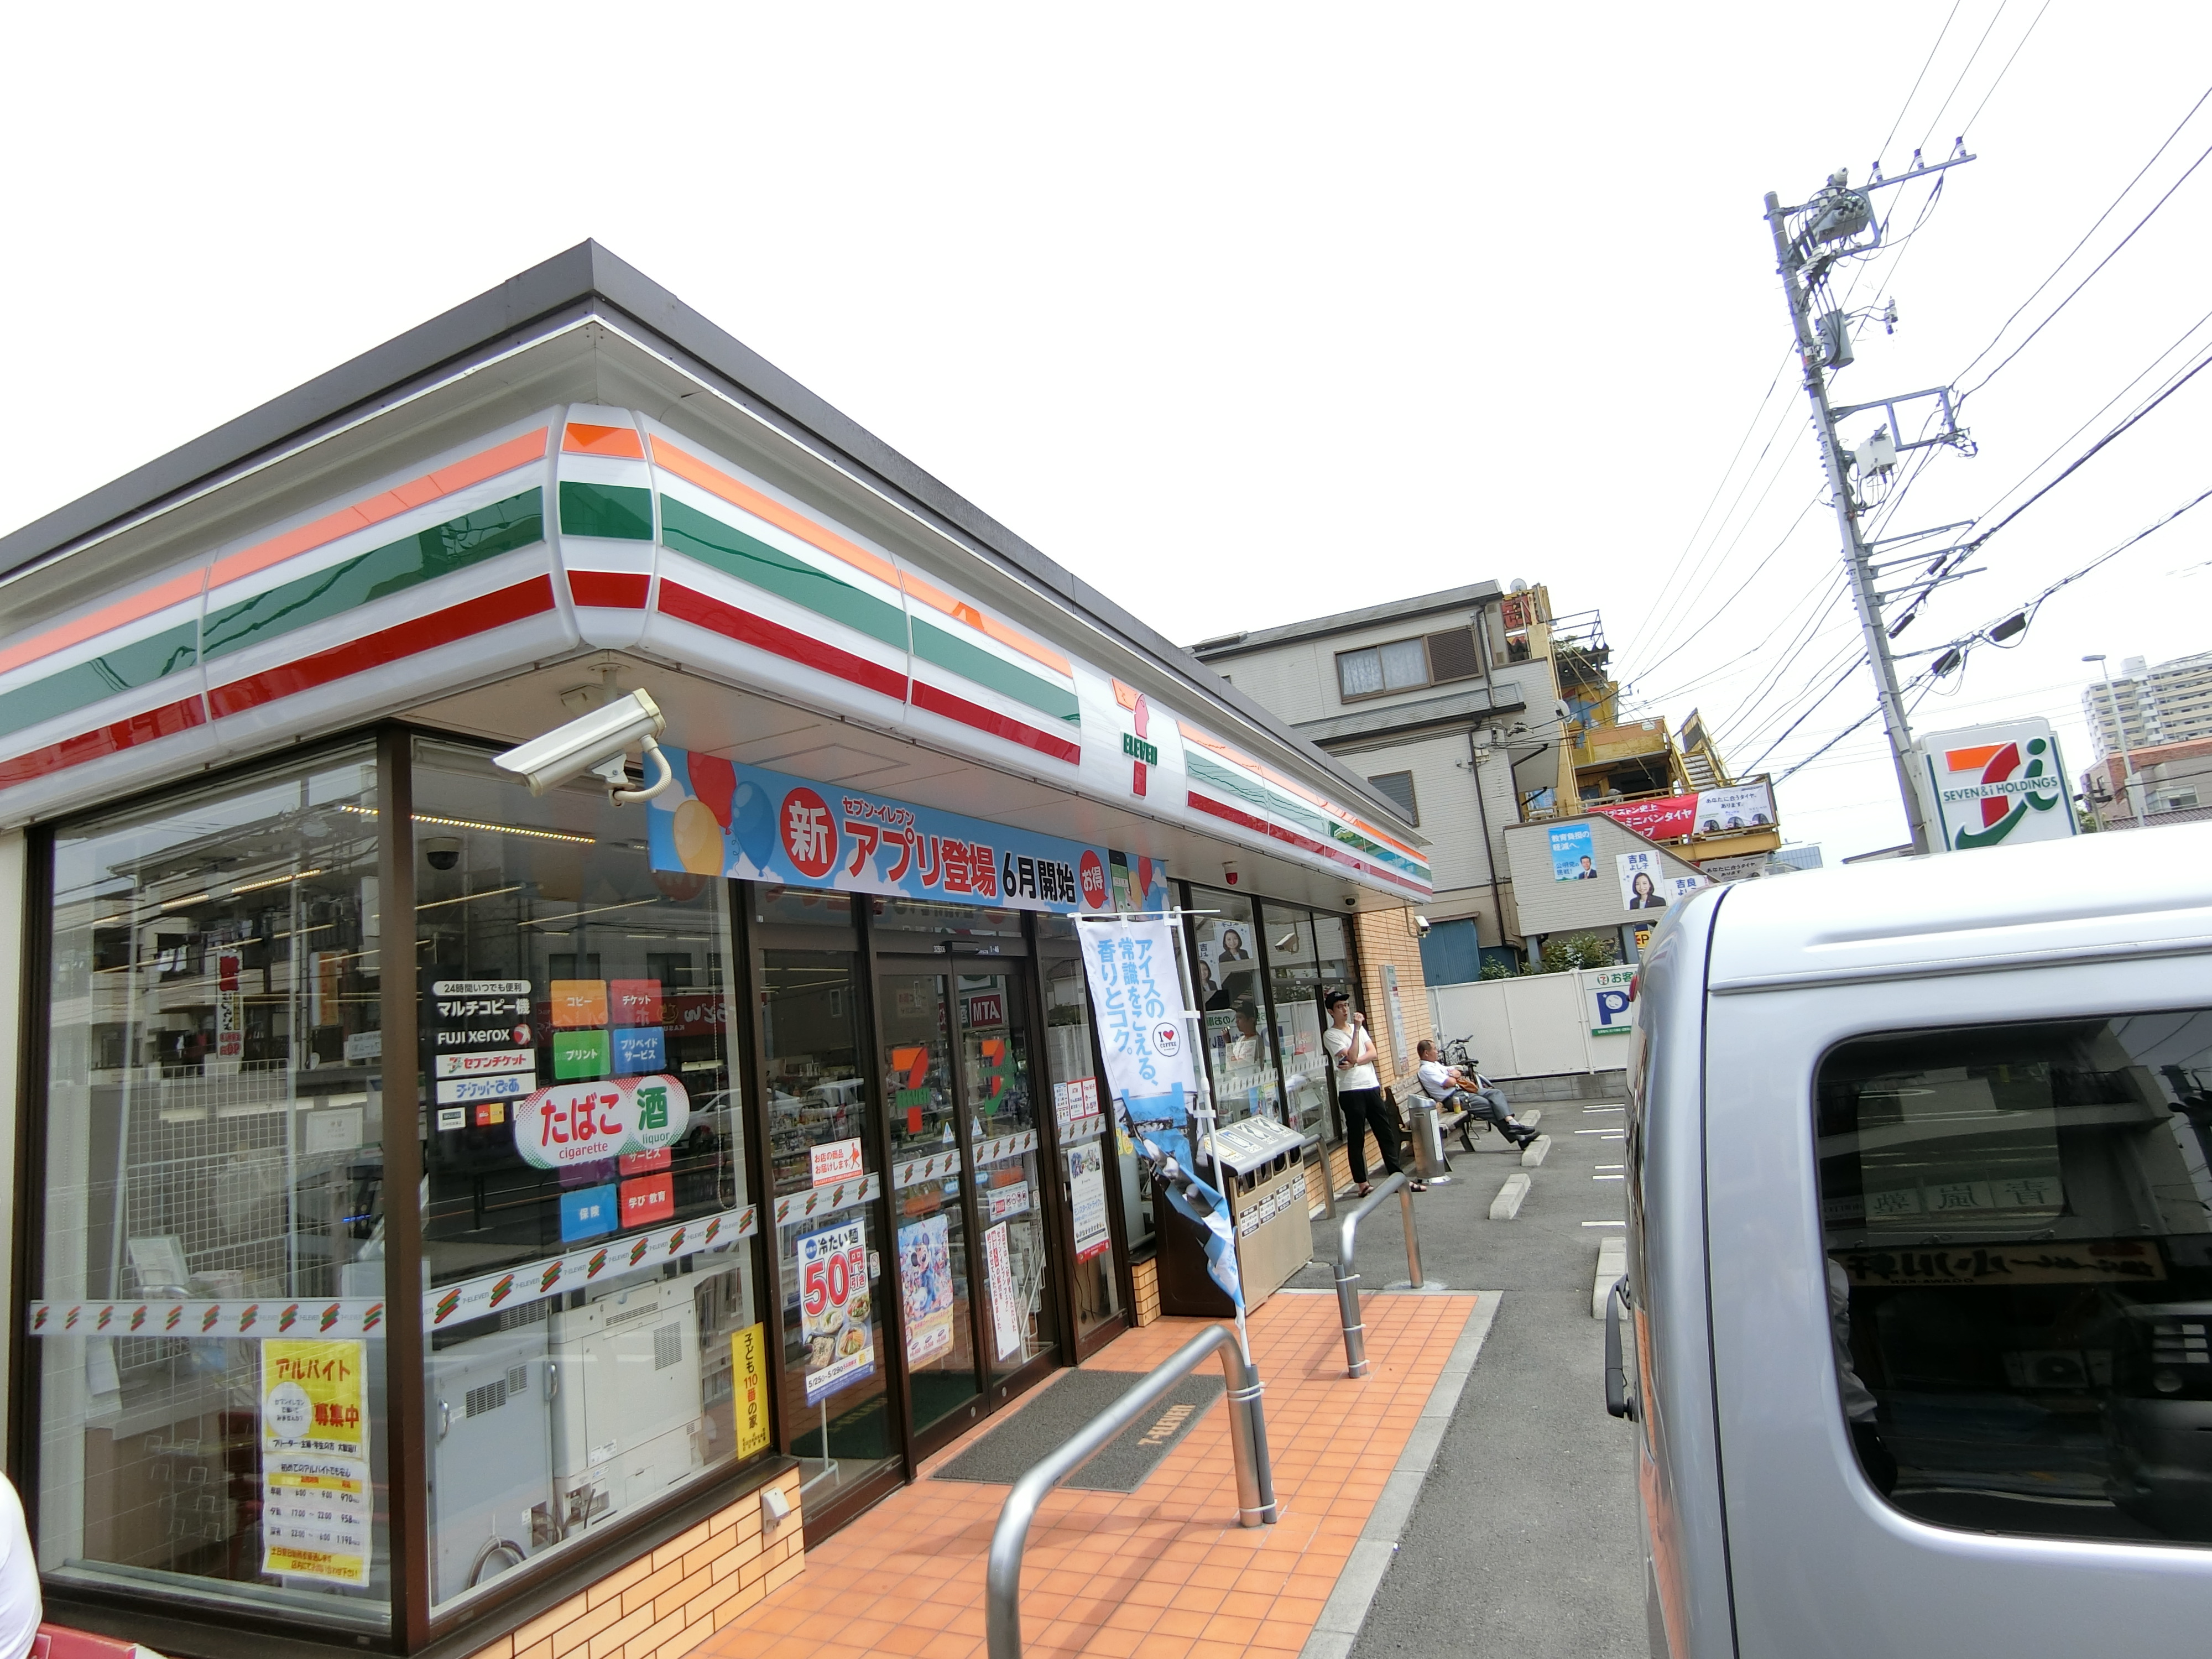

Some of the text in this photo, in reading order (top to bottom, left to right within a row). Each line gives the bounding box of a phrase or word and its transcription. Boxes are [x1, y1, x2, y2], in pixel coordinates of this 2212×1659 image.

[1123, 733, 1157, 766] ELEVEN
[1997, 776, 2058, 794] HOLDINGS
[1621, 809, 1692, 827] ミニバンタイヤ
[790, 800, 829, 865] 新
[1551, 831, 1590, 842] 教育負担の
[1552, 842, 1580, 852] 軽減へ。
[844, 822, 1076, 904] アプリ登場 6月開始
[1627, 853, 1648, 864] 吉良
[1629, 863, 1650, 871] よし子
[1081, 864, 1104, 892] お得
[1676, 878, 1697, 889] 吉良
[1641, 934, 1650, 944] P
[1135, 938, 1165, 1019] アイスの
[1611, 971, 1637, 983] お客
[444, 982, 522, 993] 24時間いつでも便利
[567, 997, 592, 1007] コピー
[622, 995, 651, 1005] チケット
[1097, 940, 1133, 1056] 香りとコク。
[437, 998, 530, 1017] マルチコピー機
[1118, 938, 1159, 1086] 常識をこえる、
[1596, 990, 1630, 1025] P
[438, 1031, 466, 1045] FUJI
[621, 1038, 658, 1049] プリペイド
[463, 1054, 526, 1068] セブンチケット
[566, 1048, 598, 1060] プリント
[624, 1049, 656, 1060] サービス
[456, 1077, 520, 1098] チケットぴあ
[637, 1086, 669, 1131] 酒
[540, 1092, 623, 1146] たばこ
[642, 1131, 670, 1146] liquor
[559, 1141, 608, 1161] cigarette
[815, 1149, 844, 1163] お店の商品
[815, 1159, 851, 1174] お届けします。
[629, 1191, 666, 1208] 学び 教育
[580, 1206, 600, 1219] 保険
[818, 1227, 859, 1255] 冷たい麺
[515, 1277, 540, 1289] 7-ELEVEN
[462, 1292, 489, 1304] 7-ELEVEN
[275, 1358, 351, 1381] アルバイト
[744, 1332, 758, 1430] 子ども110番の家
[314, 1401, 359, 1428] 募集中
